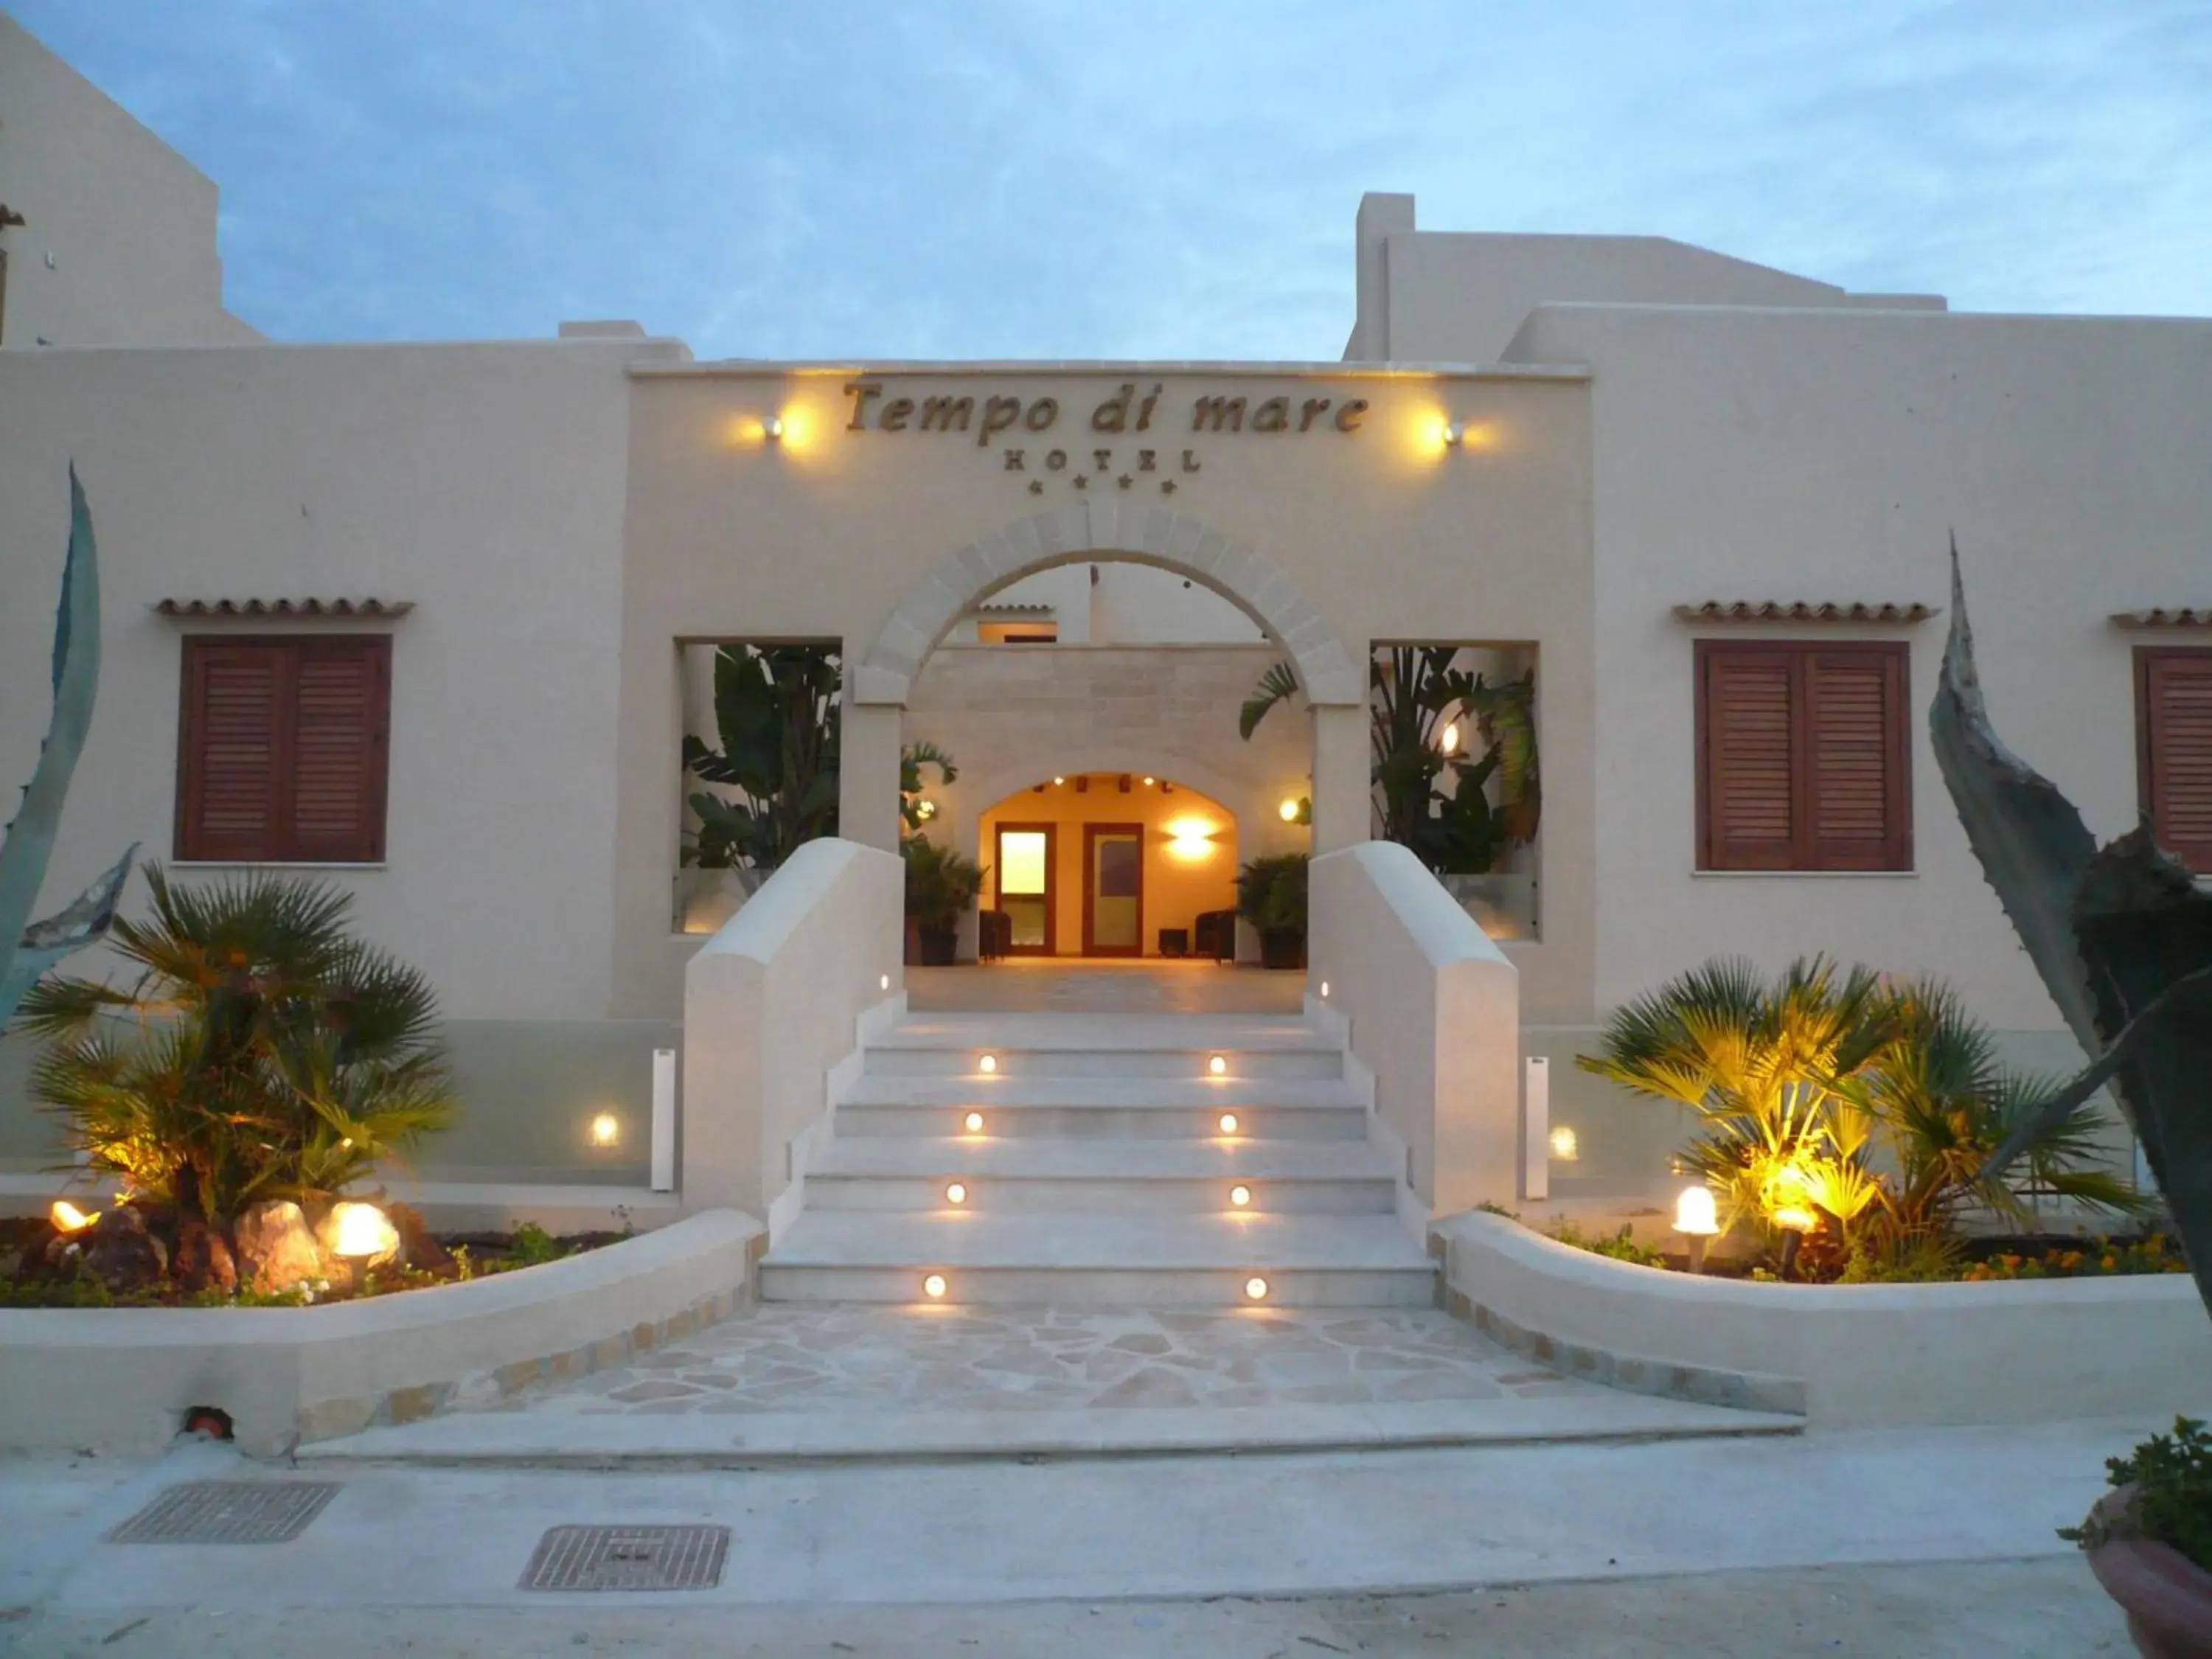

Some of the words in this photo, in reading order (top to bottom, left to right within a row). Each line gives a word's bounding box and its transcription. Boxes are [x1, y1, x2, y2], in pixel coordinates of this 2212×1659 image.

[844, 383, 1059, 447] Tempo
[1091, 383, 1163, 431] di
[1192, 395, 1369, 432] mare
[1004, 449, 1201, 472] HOTEL
